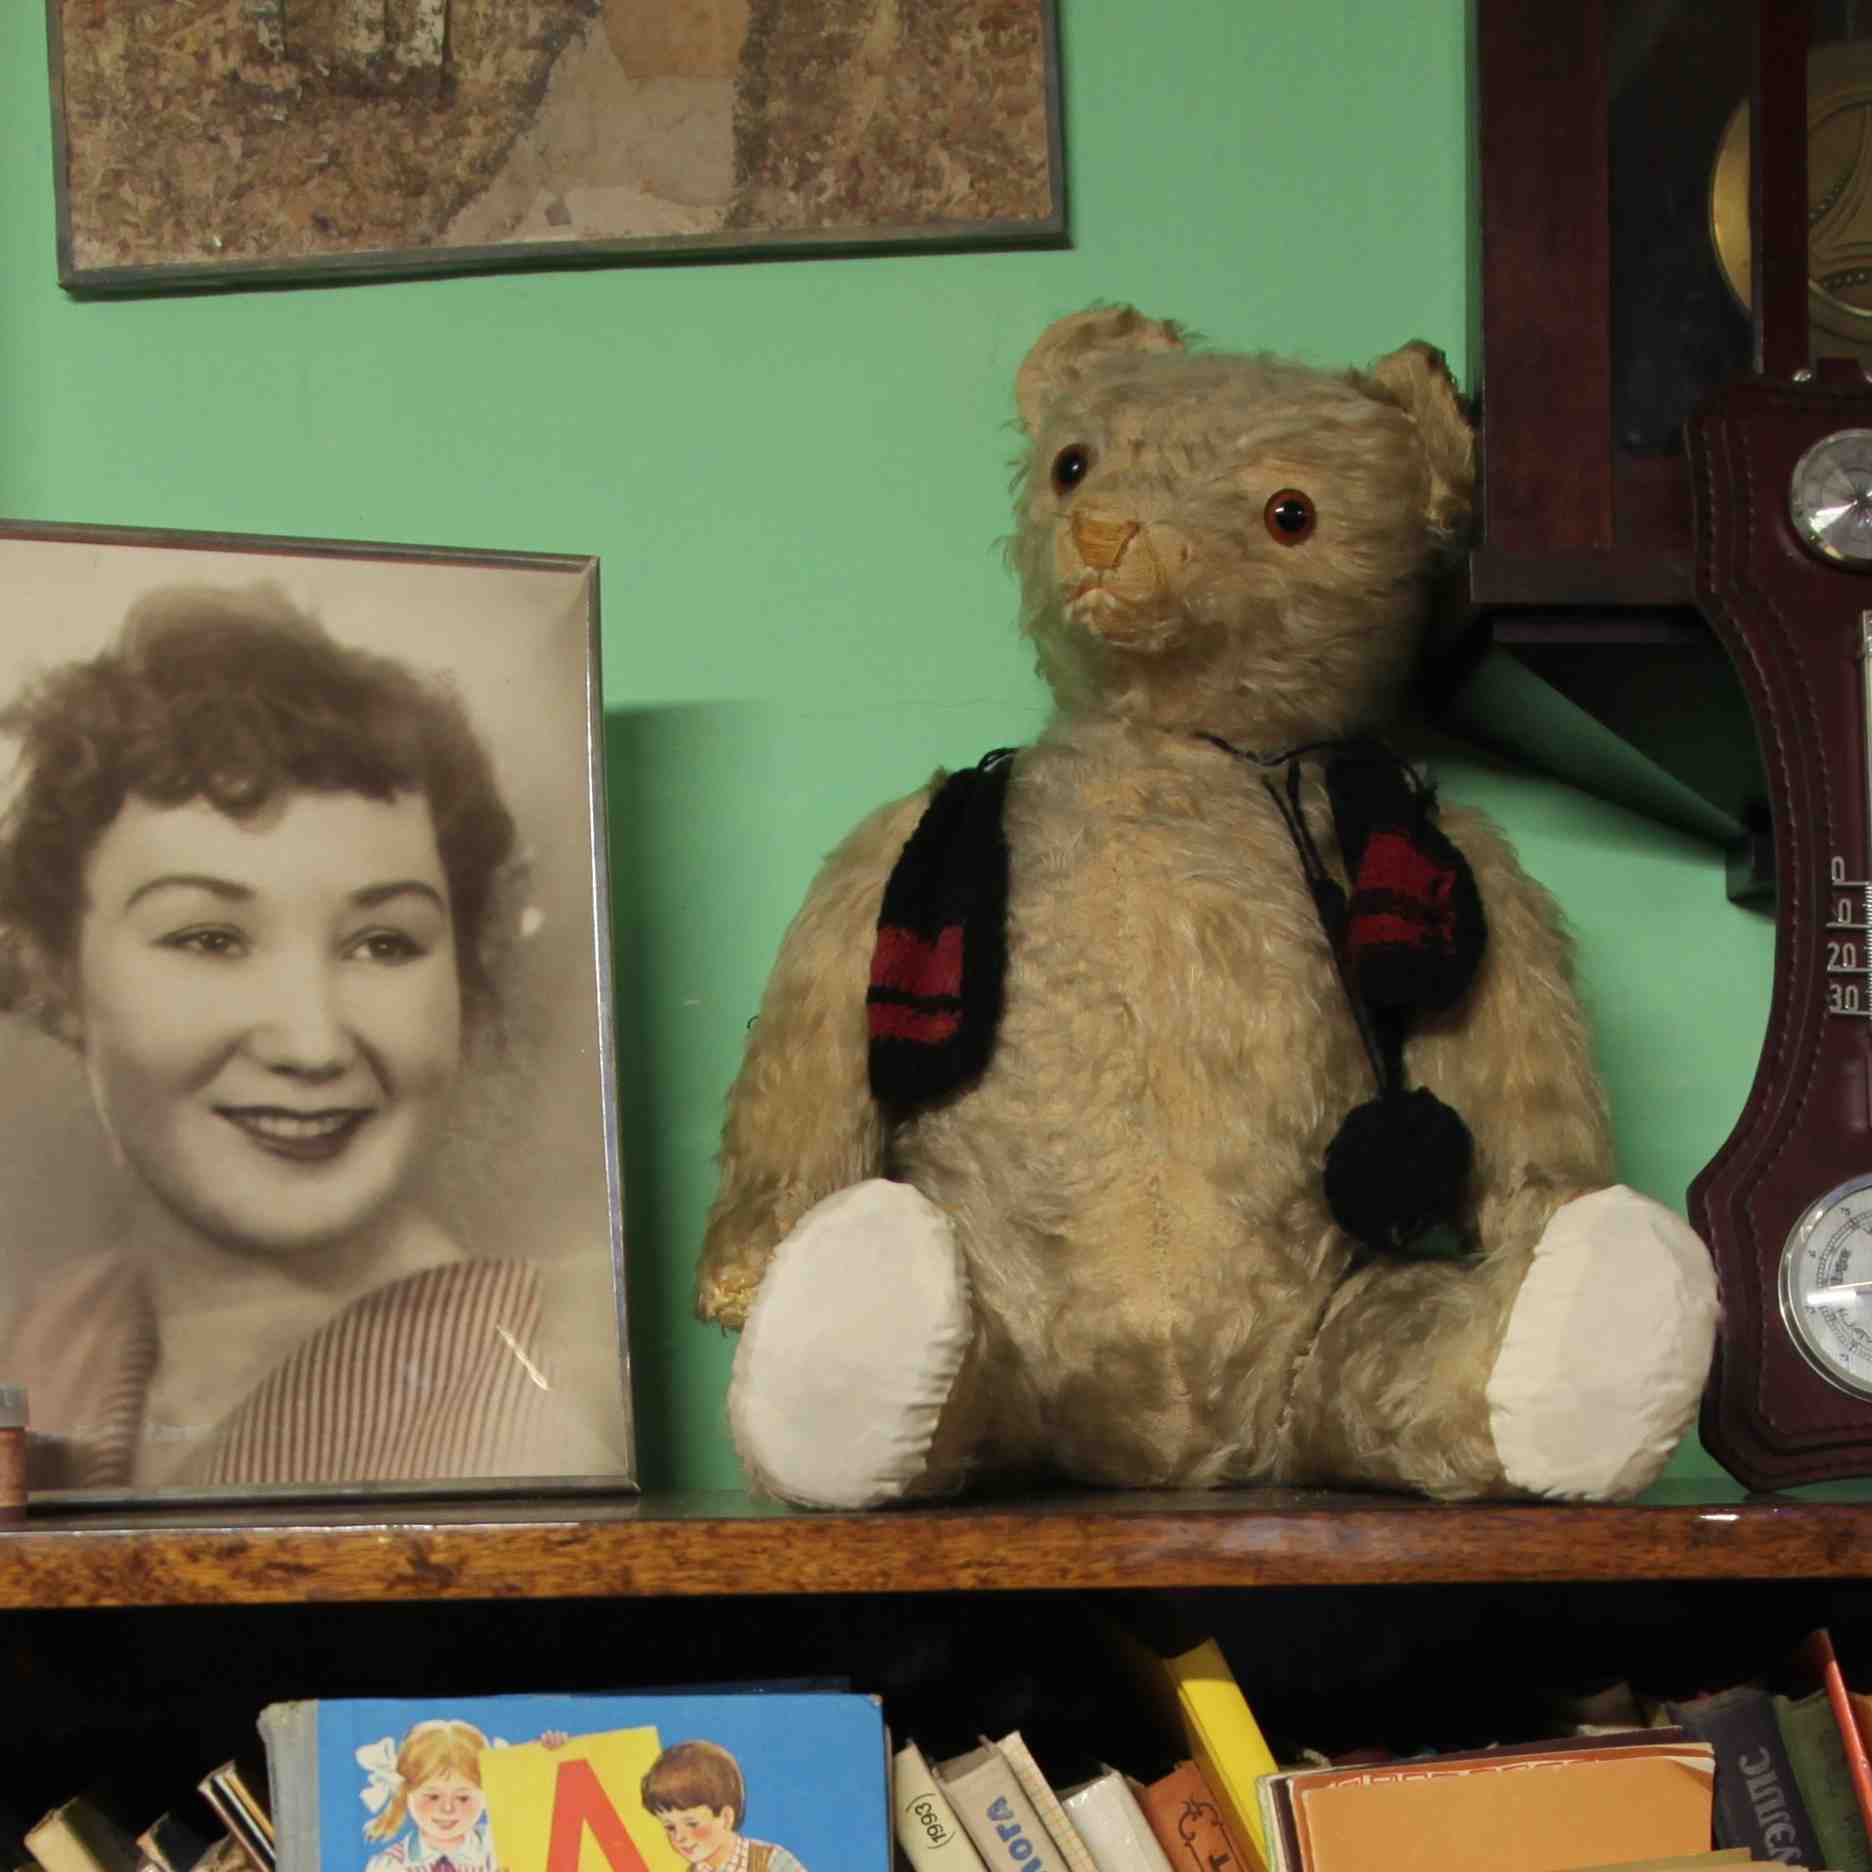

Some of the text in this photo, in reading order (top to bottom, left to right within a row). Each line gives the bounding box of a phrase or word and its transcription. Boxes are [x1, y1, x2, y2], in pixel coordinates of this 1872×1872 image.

[1830, 857, 1845, 882] 0
[1828, 944, 1857, 968] 20
[1830, 986, 1859, 1010] 30
[905, 1792, 957, 1850] (1993)
